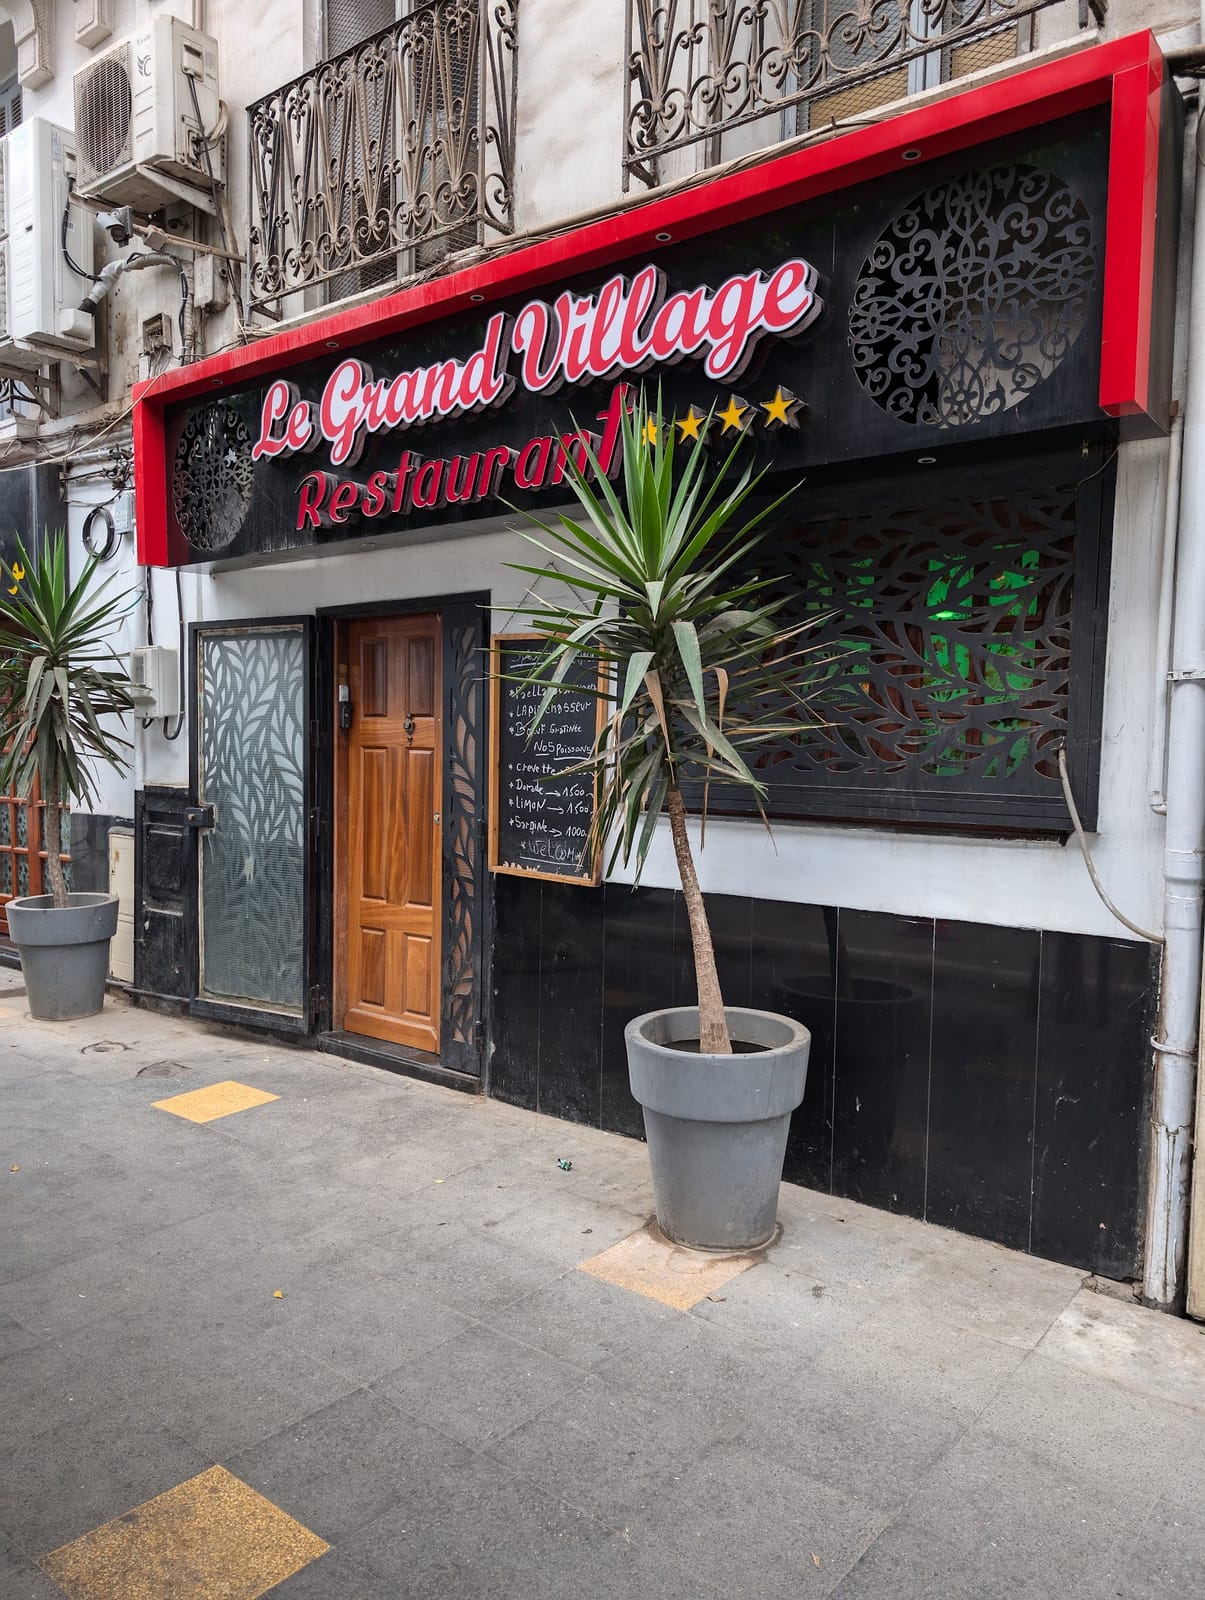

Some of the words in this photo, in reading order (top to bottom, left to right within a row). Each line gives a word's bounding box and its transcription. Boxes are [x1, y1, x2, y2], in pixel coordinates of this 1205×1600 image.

[251, 378, 312, 462] Le
[319, 311, 507, 467] Grand
[512, 257, 817, 393] Village
[296, 382, 634, 531] Restaurant
[562, 783, 585, 798] 1500
[566, 801, 589, 815] 1500
[565, 826, 586, 838] 1000
